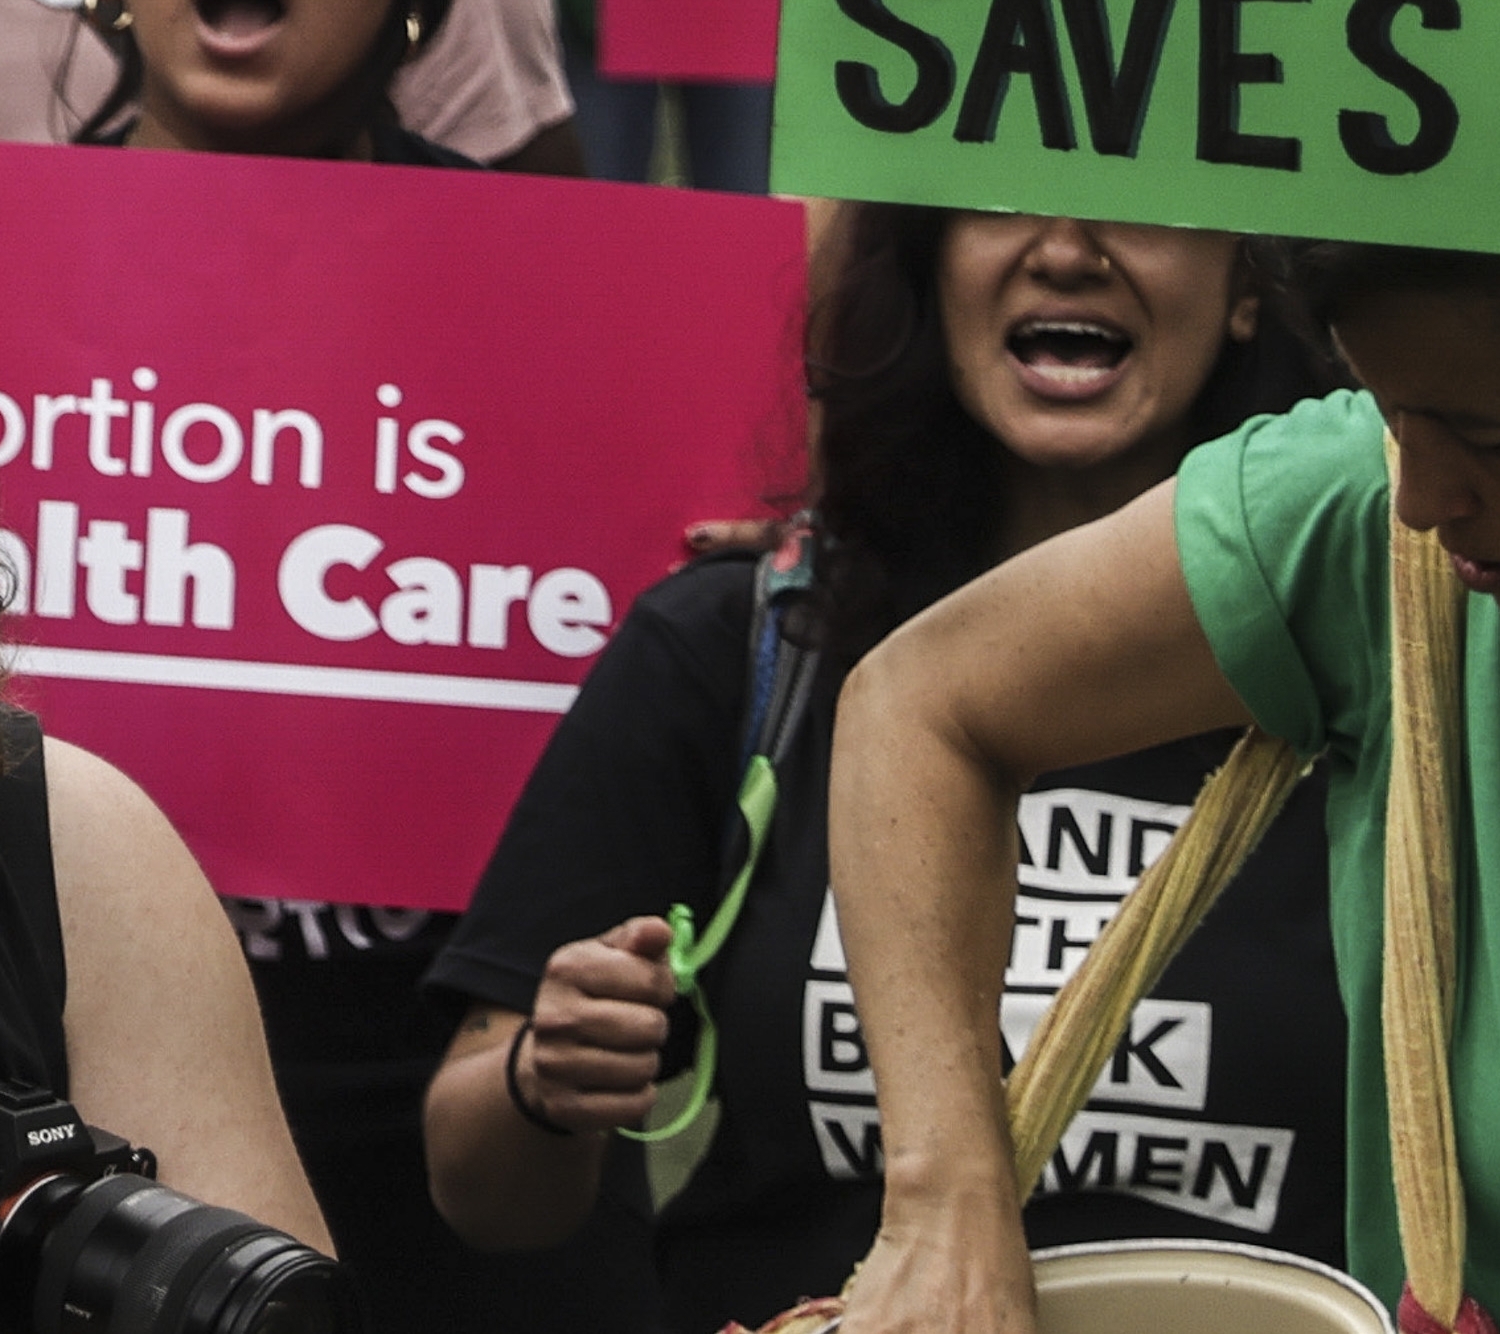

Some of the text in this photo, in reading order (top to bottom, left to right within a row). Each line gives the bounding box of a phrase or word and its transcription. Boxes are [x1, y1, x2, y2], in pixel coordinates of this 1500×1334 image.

[373, 382, 467, 502] is
[276, 522, 612, 657] Care
[28, 1124, 75, 1147] SONY
[822, 1119, 1273, 1210] WMEN
